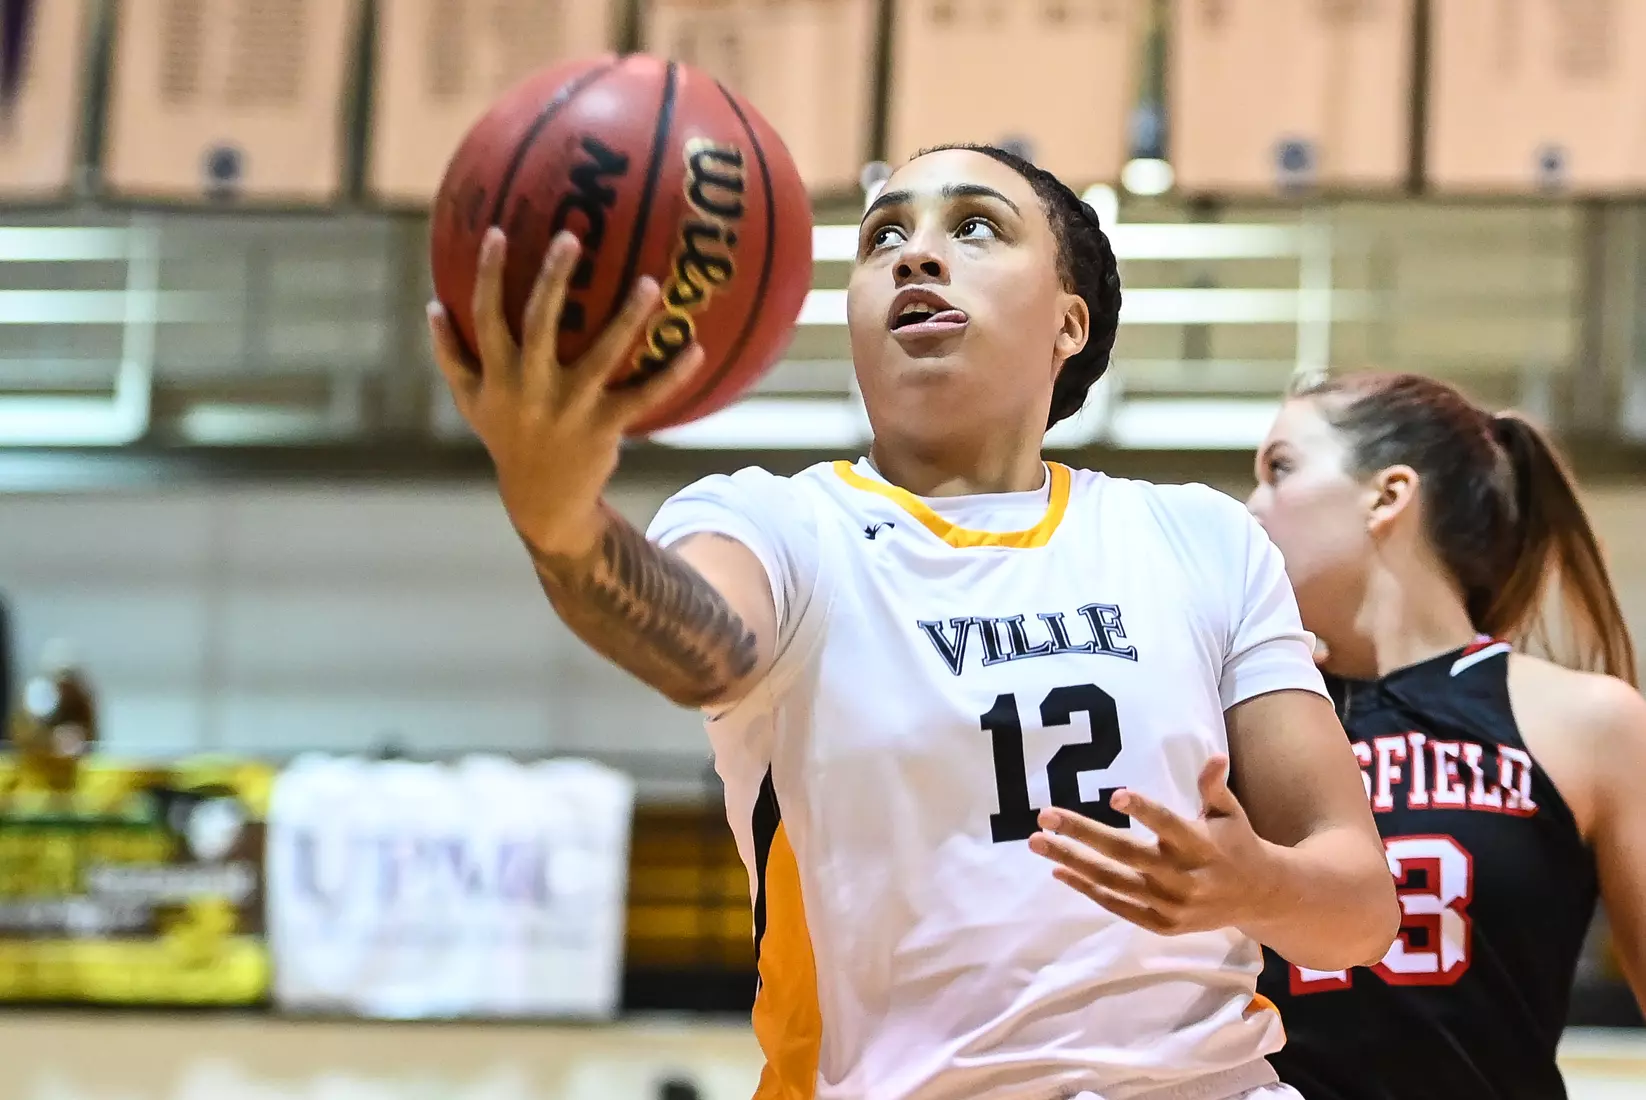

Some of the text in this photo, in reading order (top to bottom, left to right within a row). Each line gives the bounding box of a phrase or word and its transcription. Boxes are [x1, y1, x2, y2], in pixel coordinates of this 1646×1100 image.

[917, 603, 1138, 676] VILLE
[980, 683, 1131, 843] 12
[1289, 834, 1474, 995] 3
